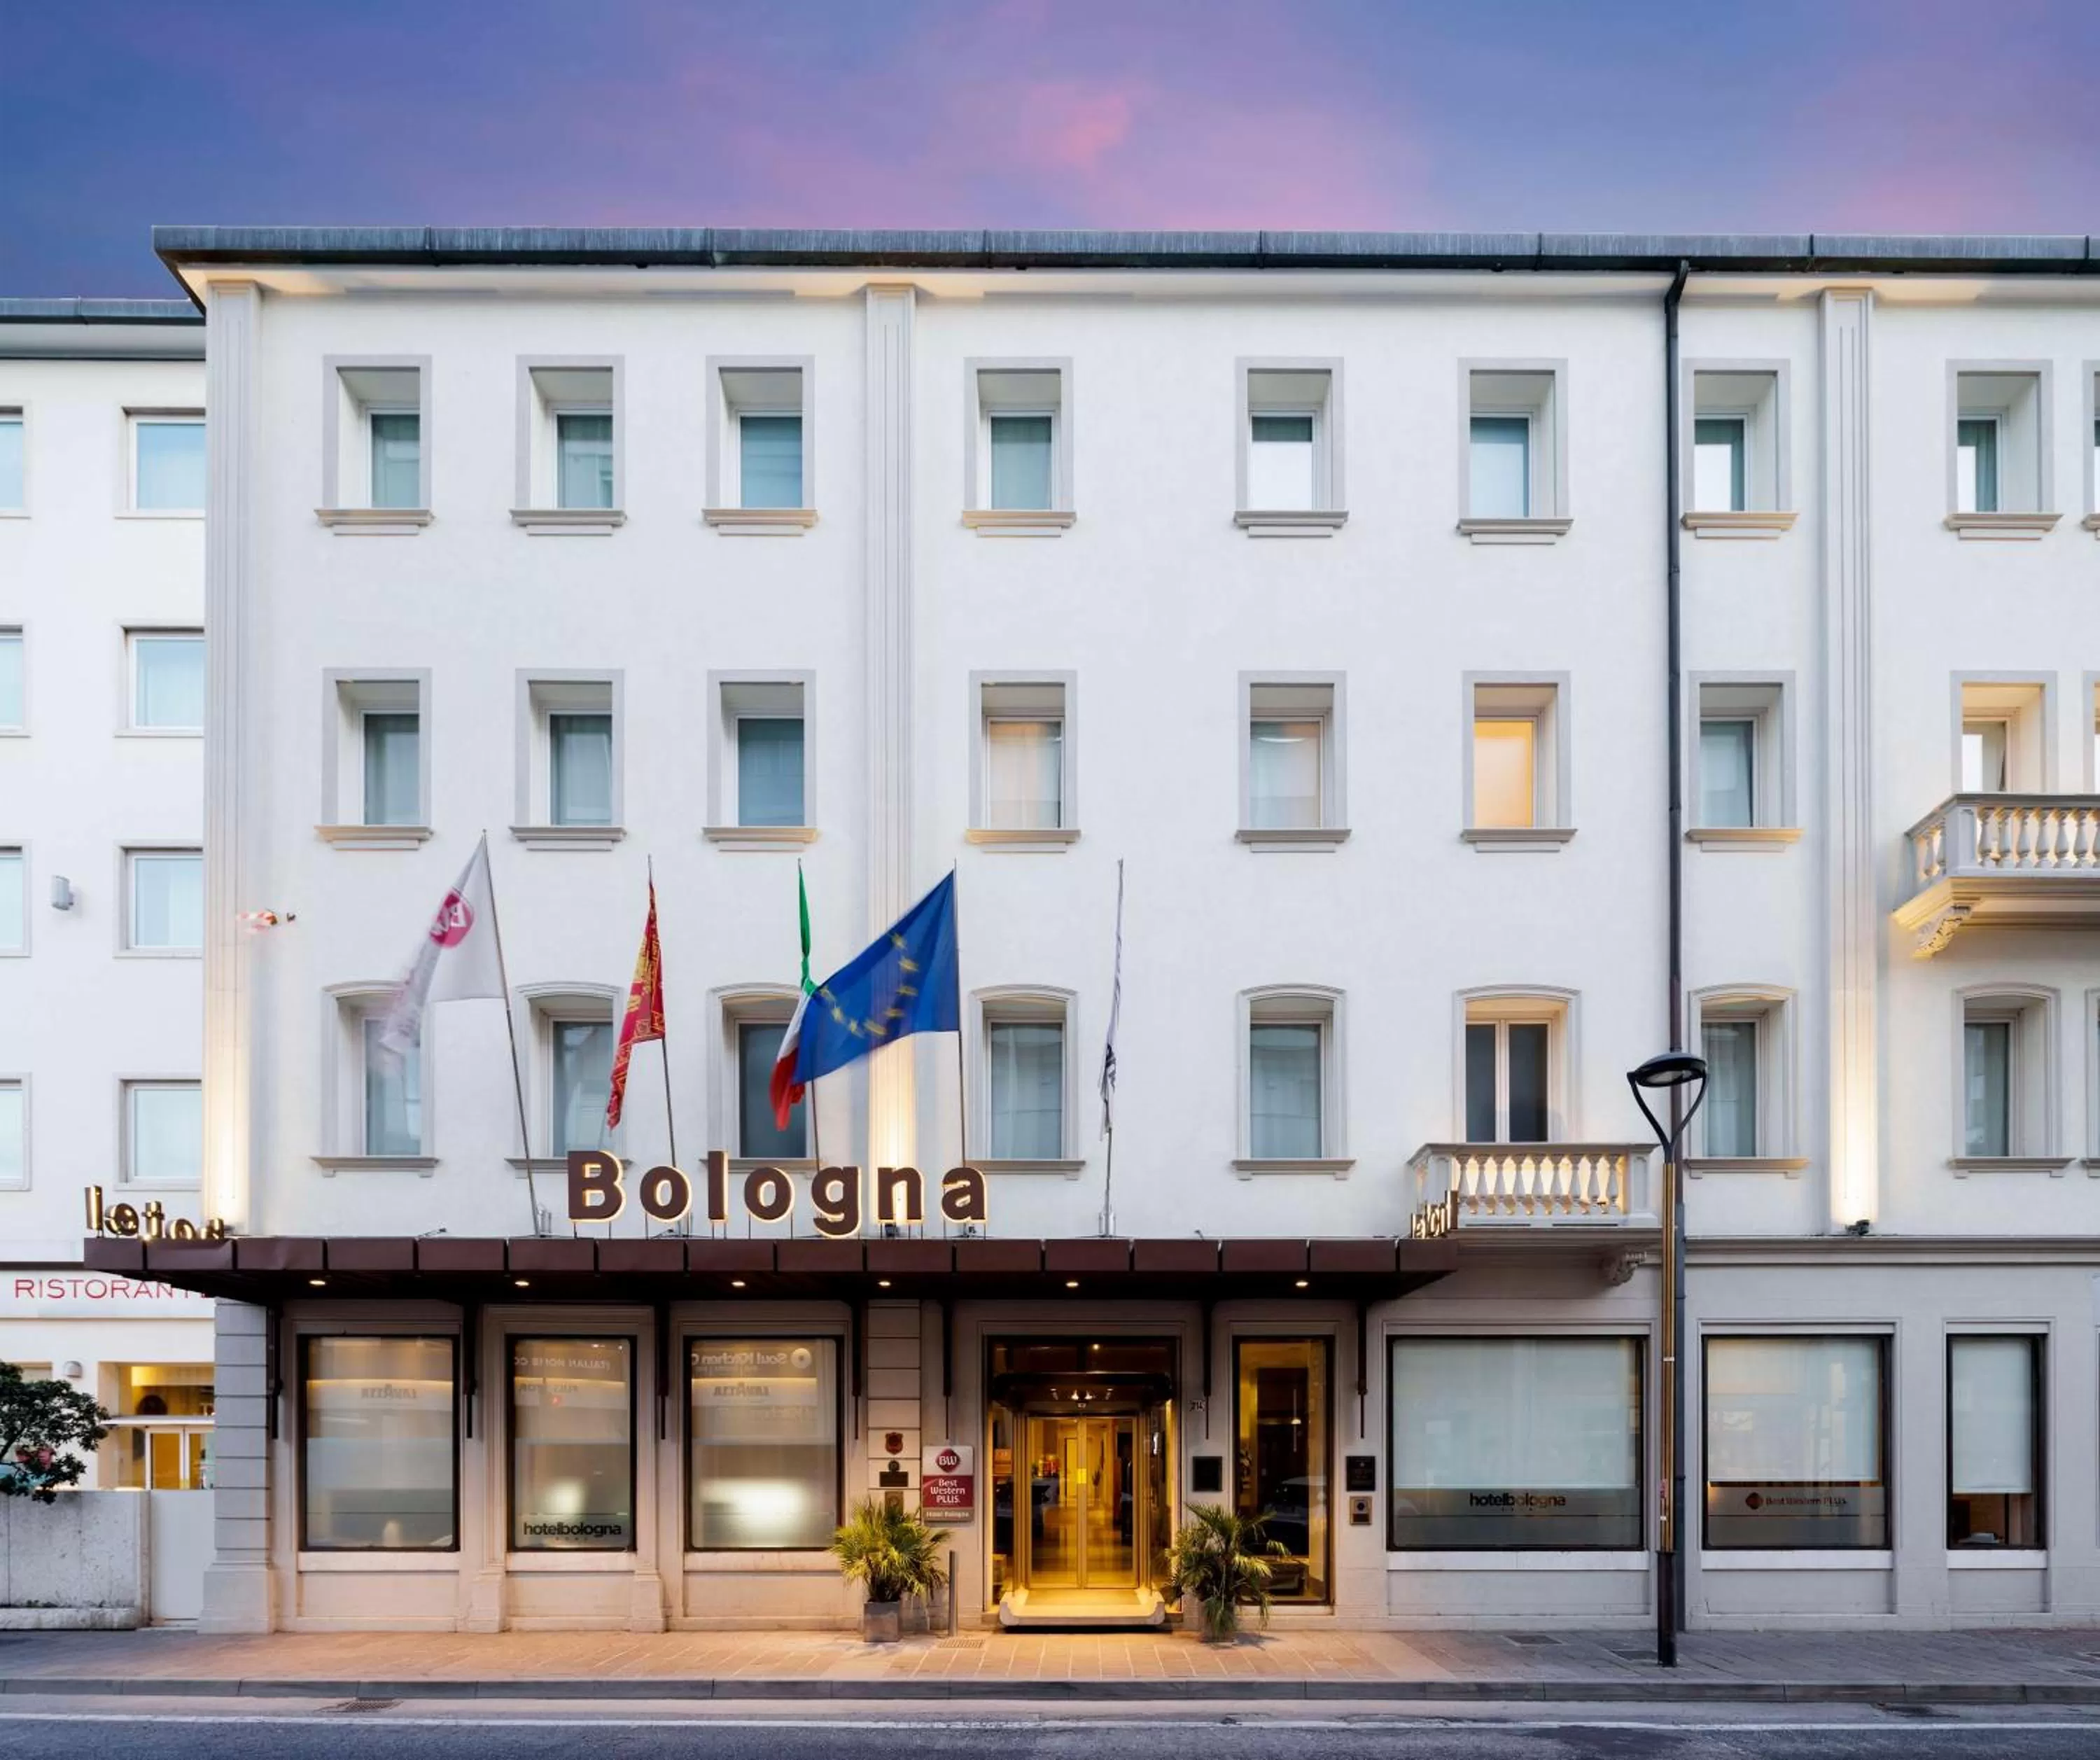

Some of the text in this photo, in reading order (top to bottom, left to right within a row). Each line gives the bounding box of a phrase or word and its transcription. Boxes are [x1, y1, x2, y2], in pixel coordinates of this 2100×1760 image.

[568, 1150, 986, 1238] Bologna
[14, 1279, 208, 1299] RISTORAN
[939, 1455, 957, 1465] BW
[930, 1486, 966, 1495] Western
[939, 1479, 958, 1487] Best
[1470, 1493, 1567, 1509] hotelbologna
[523, 1521, 622, 1537] hotelbologna
